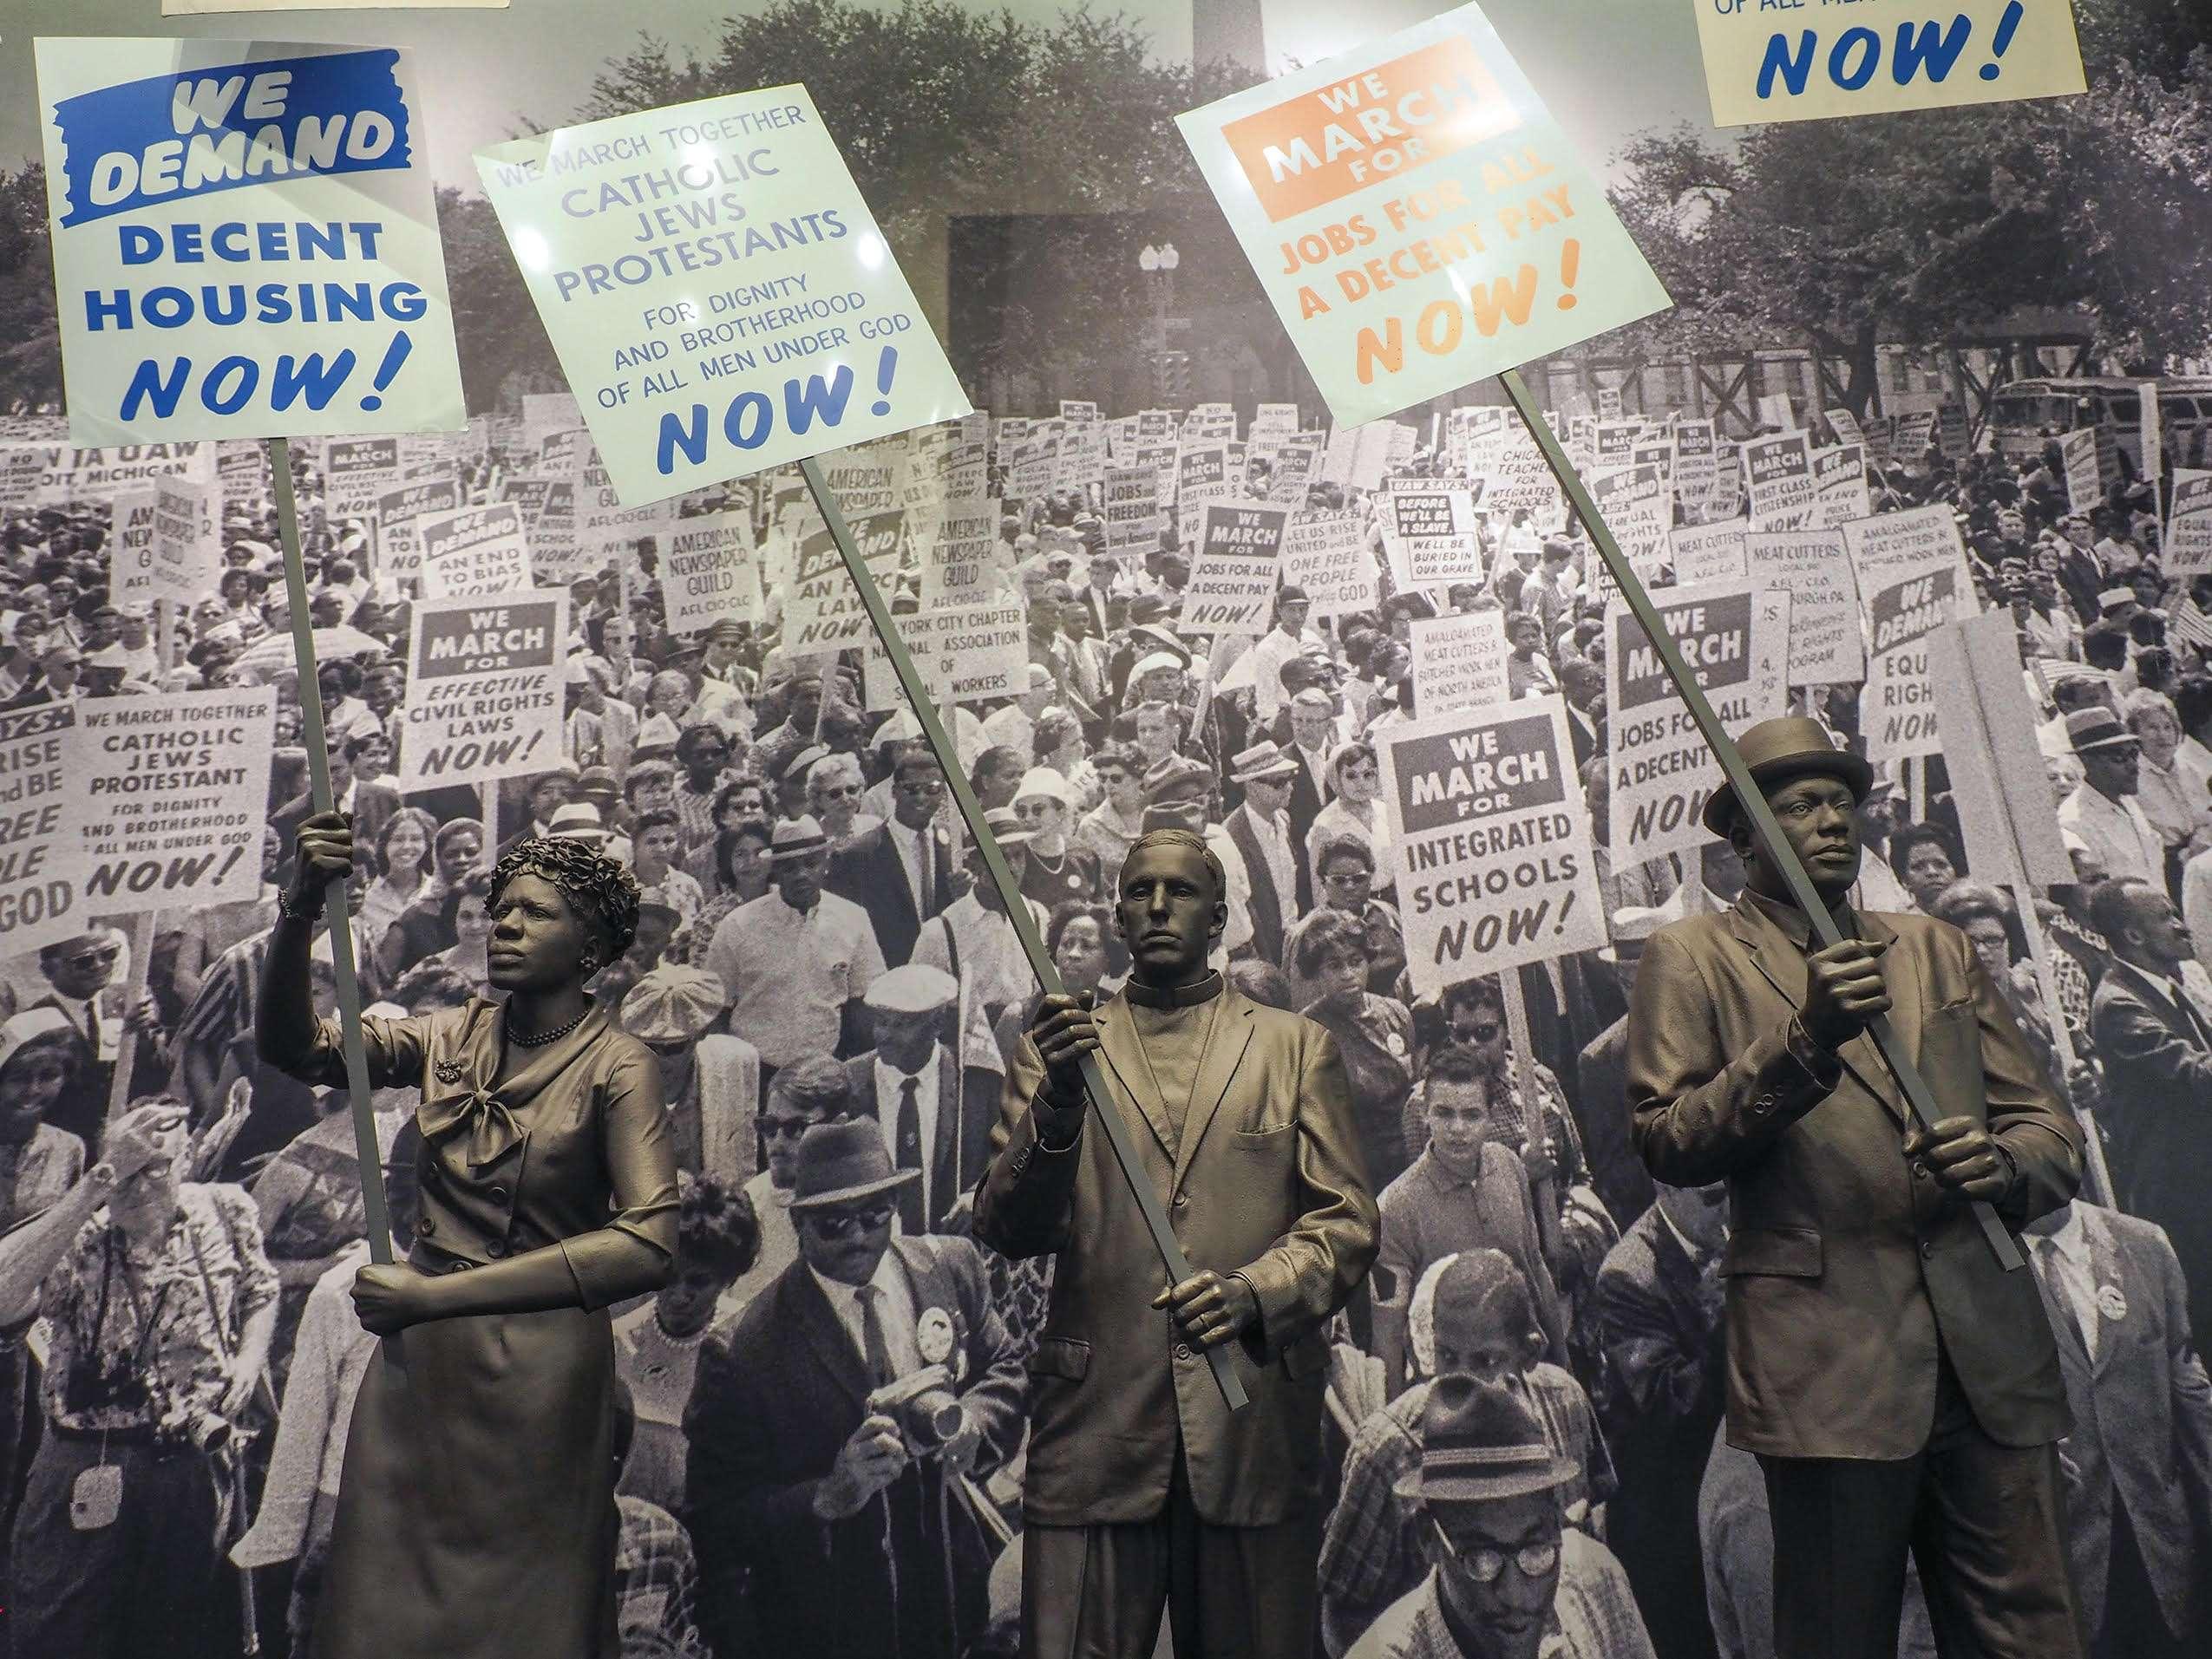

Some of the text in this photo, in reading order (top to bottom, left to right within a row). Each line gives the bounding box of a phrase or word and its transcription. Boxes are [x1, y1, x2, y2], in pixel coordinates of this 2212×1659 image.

[1756, 0, 2024, 99] NOW!
[173, 70, 293, 134] WE
[1318, 72, 1389, 114] WE
[1262, 72, 1478, 184] MARCH
[552, 134, 651, 178] MARCH
[659, 104, 807, 149] TOGETHER
[89, 110, 396, 206] DEMAND
[1347, 136, 1430, 182] FOR
[560, 148, 780, 219] CATHOLIC
[633, 192, 746, 243] JEWS
[1279, 144, 1556, 276] JOBS FOR ALL
[119, 222, 383, 265] DECENT
[553, 208, 847, 302] PROTESTANTS
[1298, 183, 1576, 320] A DECENT PAY
[84, 281, 428, 331] HOUSING
[643, 272, 808, 330] FOR DIGNITY
[1355, 238, 1581, 385] NOW!
[612, 291, 867, 371] AND BROTHERHOOD
[597, 314, 912, 409] OF ALL MEN UNDER GOD
[120, 330, 412, 421] NOW!
[657, 345, 899, 476] NOW!
[1679, 437, 1712, 449] MARCH
[1762, 443, 1783, 455] WE
[334, 450, 392, 464] MARCH
[1191, 454, 1206, 465] WE
[1752, 452, 1803, 475] MARCH
[1181, 462, 1221, 478] MARCH
[1515, 476, 1538, 485] FOR
[1766, 468, 1789, 479] FOR
[403, 487, 431, 505] WE
[1109, 485, 1142, 500] JOBS
[1487, 487, 1555, 499] INTEGRATED
[1753, 485, 1777, 501] FIRST
[1780, 479, 1813, 495] CLASS
[385, 494, 454, 524] DEMAND
[1107, 503, 1156, 521] FREEDOM
[1397, 498, 1448, 509] BEFORE
[1489, 495, 1552, 510] SCHOOLS
[1754, 491, 1816, 516] CITIZENSHIP
[453, 511, 487, 533] WE
[1237, 513, 1262, 526] WE
[1434, 510, 1450, 521] BE
[1764, 509, 1814, 533] NOW!
[389, 527, 413, 539] AN
[431, 518, 517, 557] DEMAND
[938, 516, 992, 541] AMERICAN
[1211, 526, 1278, 545] MARCH
[1310, 523, 1358, 538] US RISE
[1400, 523, 1409, 534] A
[1863, 517, 1940, 540] AMALGAMATED
[389, 540, 411, 552] TO
[671, 526, 741, 556] AMERICAN
[932, 539, 993, 565] NEWSPAPER
[1227, 545, 1255, 555] FOR
[1286, 534, 1359, 554] UNITED BE
[1450, 539, 1464, 548] BE
[1678, 538, 1703, 556] MEAT
[1754, 543, 1841, 562] MEAT CUTTERS
[1861, 532, 1934, 558] MEAT CUTTERS
[1907, 544, 1957, 561] WORK MEN
[439, 548, 520, 571] AN END
[532, 547, 584, 563] NOW!
[668, 547, 749, 578] NEWSPAPER
[1291, 551, 1359, 572] ONE FREE
[1414, 552, 1457, 562] BURIED
[442, 562, 520, 585] TO BIAS
[943, 565, 979, 588] GUILD
[1195, 564, 1273, 577] JOBS FOR ALL
[1301, 568, 1357, 586] PEOPLE
[1416, 564, 1475, 575] OUR GRAVE
[687, 571, 733, 597] GUILD
[800, 580, 832, 600] AN
[1191, 583, 1270, 596] A DECENT PAY
[1338, 584, 1369, 603] GOD
[1901, 577, 1934, 611] WE
[469, 610, 511, 630] WE
[680, 604, 704, 617] AFL
[900, 609, 1021, 635] YORK CITY CHAPTER
[1191, 603, 1263, 624] NOW!
[1663, 607, 1706, 637] WE
[429, 626, 546, 660] MARCH
[944, 630, 1021, 651] ASSOCIATION
[463, 656, 510, 672] FOR
[940, 659, 954, 674] OF
[427, 674, 548, 702] EFFECTIVE
[952, 673, 1008, 695] WORKERS
[85, 703, 268, 728] WE MARCH TOGETHER
[409, 691, 555, 723] CIVIL RIGHTS
[447, 716, 514, 738] LAWS
[1617, 697, 1751, 753] JOBS ALL
[102, 727, 245, 753] CATHOLIC
[1449, 730, 1500, 763] WE
[127, 749, 213, 772] JEWS
[418, 728, 545, 776] NOW!
[1410, 749, 1550, 807] MARCH
[1616, 746, 1709, 791] A DECENT
[28, 767, 62, 796] BE
[89, 767, 247, 795] PROTESTANT
[111, 795, 223, 816] FOR DIGNITY
[1457, 793, 1513, 818] FOR
[124, 813, 249, 835] BROTHERHOOD
[94, 832, 252, 855] ALL MEN UNDER GOD
[1406, 813, 1572, 872] INTEGRATED
[85, 845, 245, 897] NOW!
[1412, 852, 1580, 915] SCHOOLS
[1435, 890, 1576, 965] NOW!
